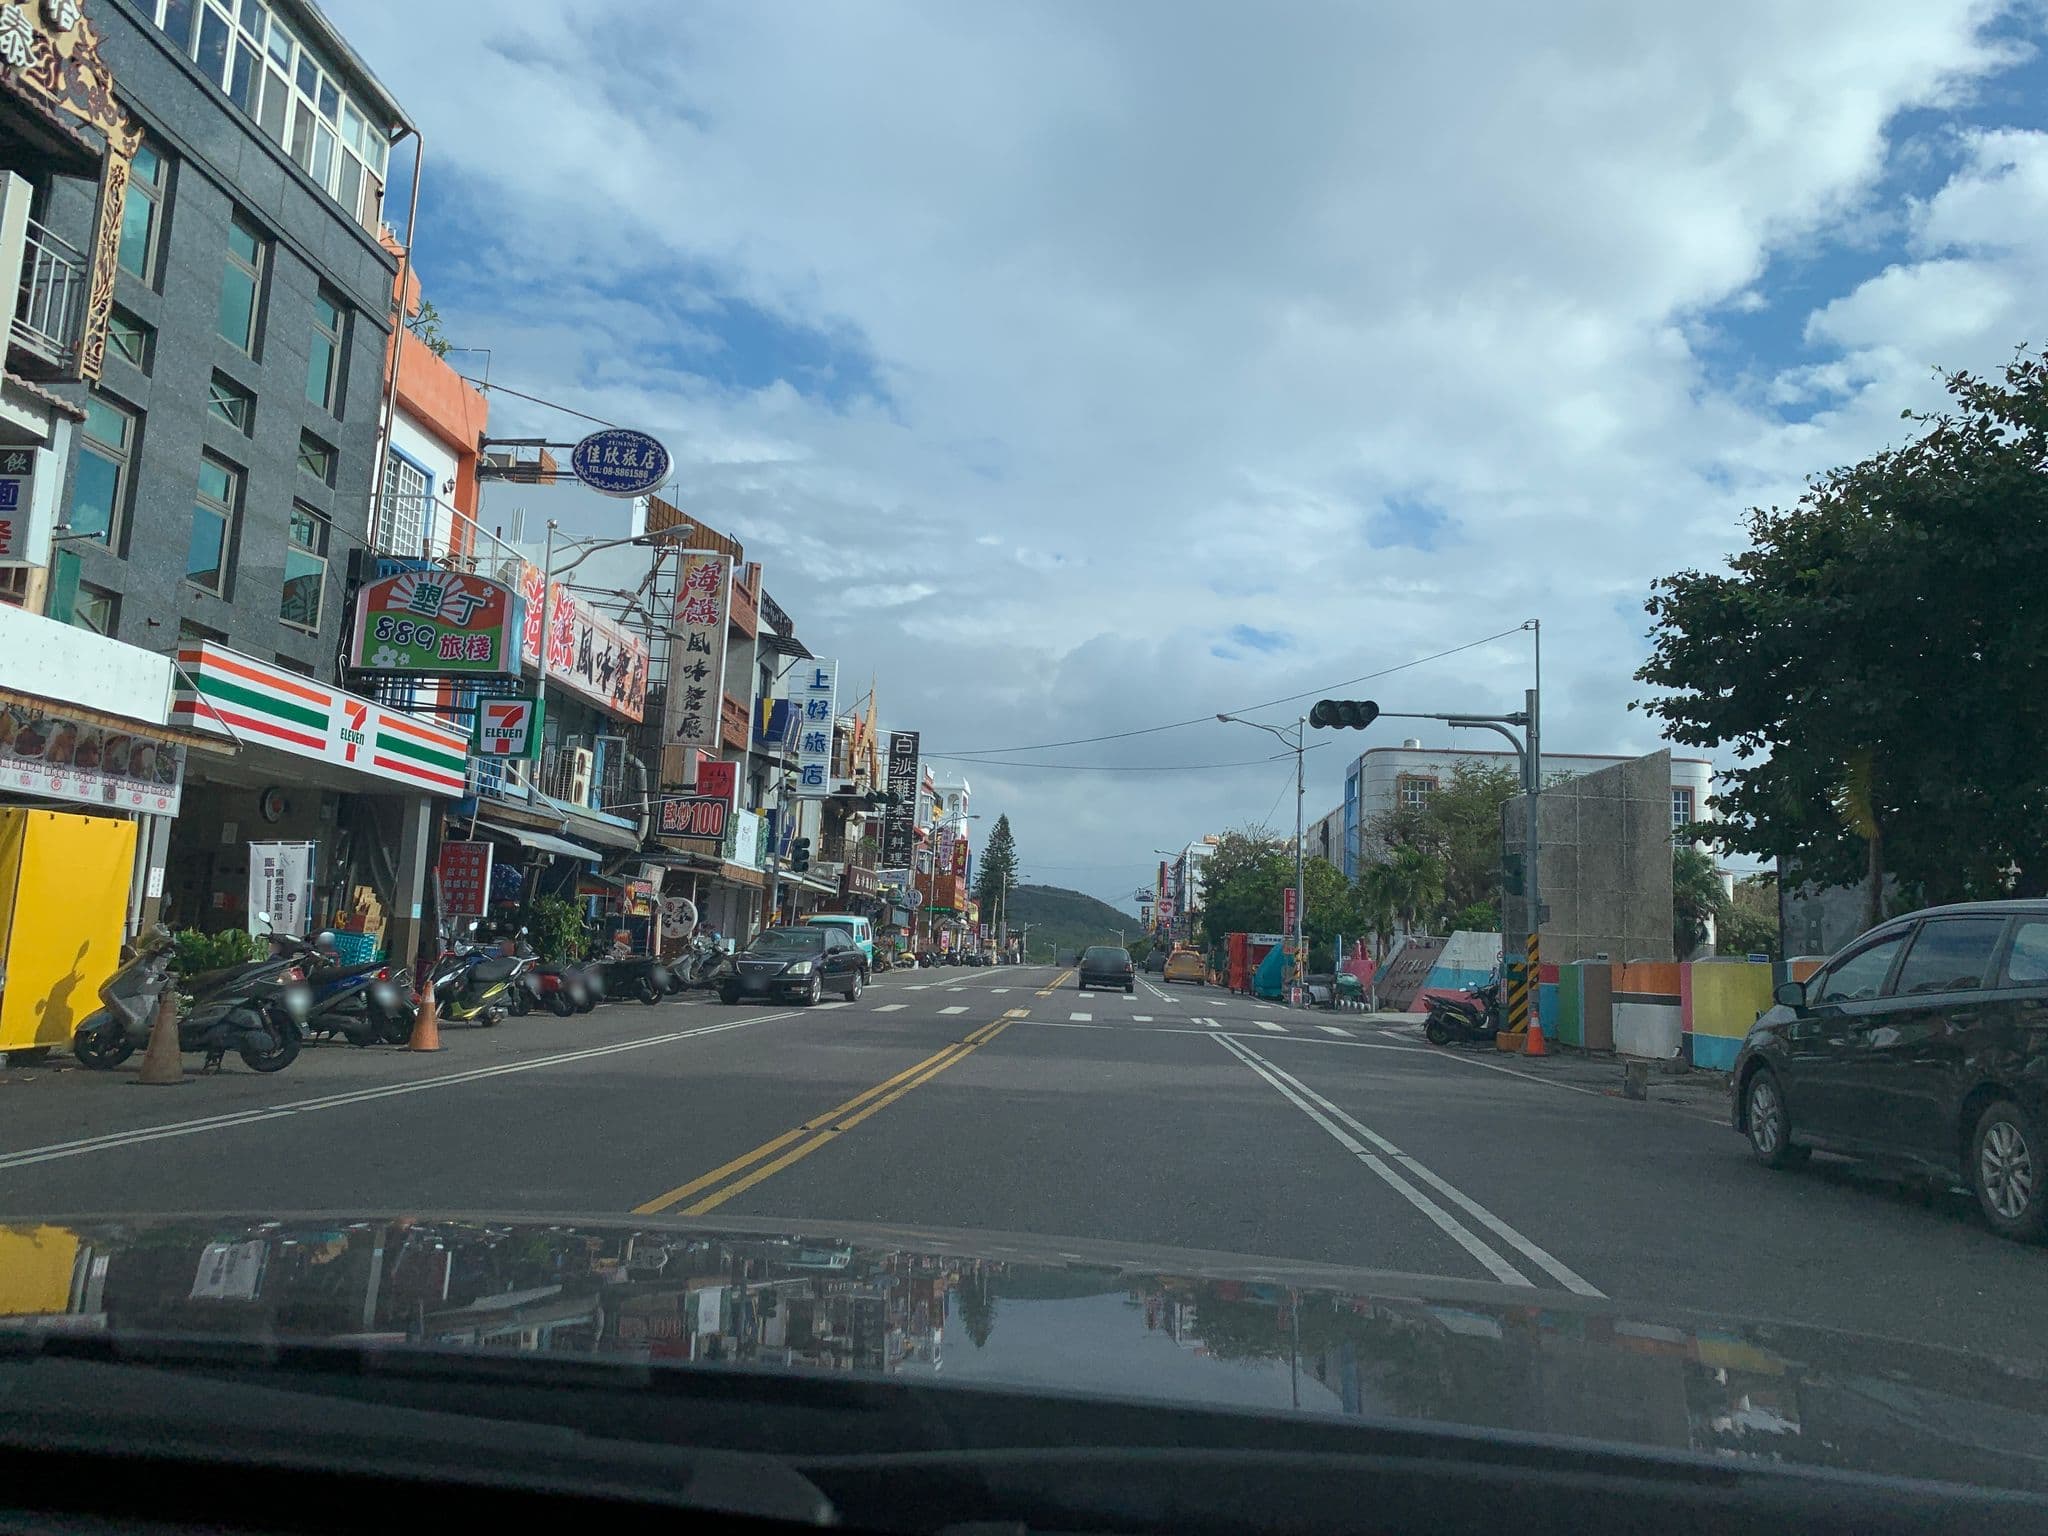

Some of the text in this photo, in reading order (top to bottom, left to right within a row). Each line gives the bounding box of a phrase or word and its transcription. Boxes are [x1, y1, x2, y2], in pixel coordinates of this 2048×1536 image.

[407, 581, 487, 626] 墾丁
[801, 668, 830, 785] 上好旅店
